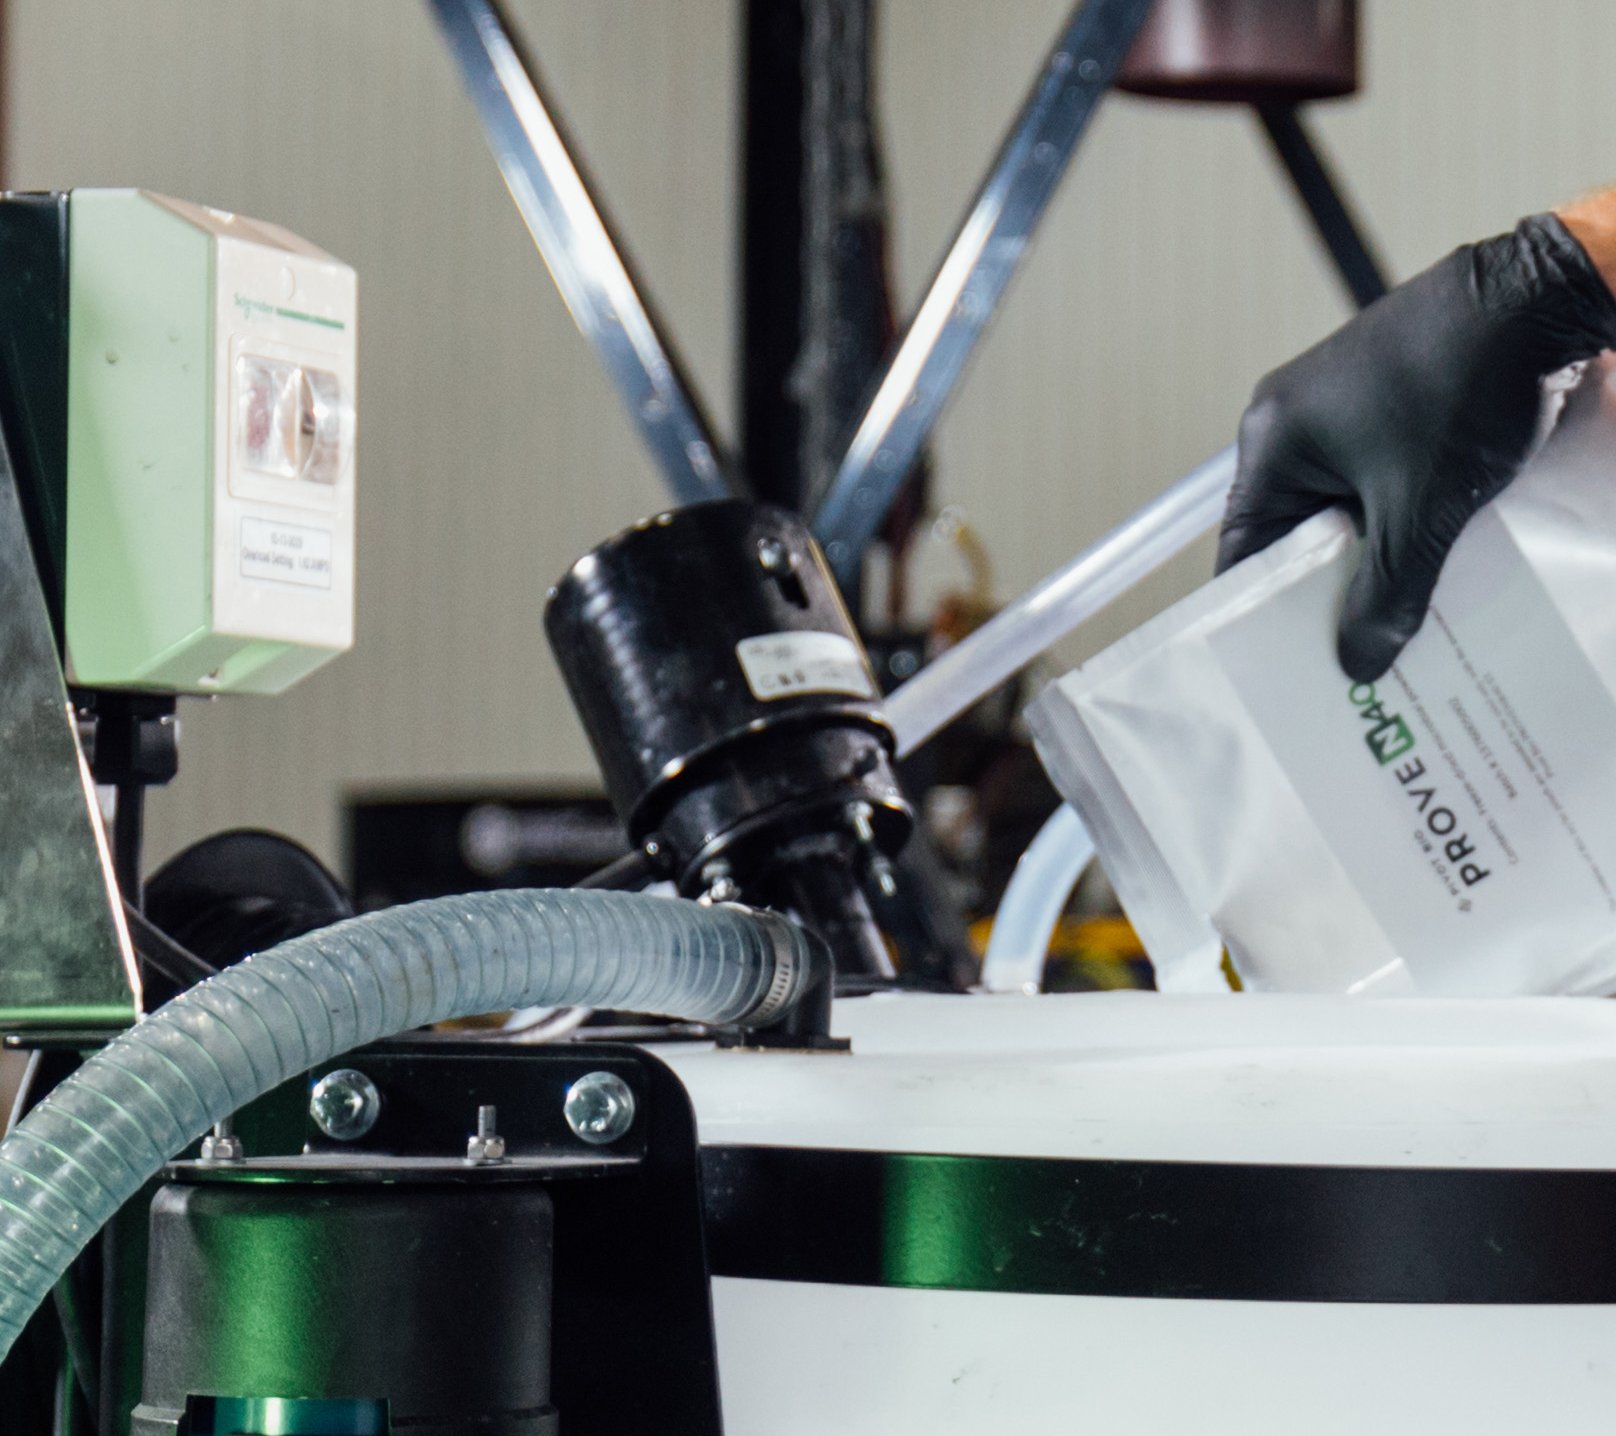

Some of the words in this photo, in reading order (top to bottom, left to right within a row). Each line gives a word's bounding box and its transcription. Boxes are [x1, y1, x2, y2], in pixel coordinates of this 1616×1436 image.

[1411, 702, 1448, 752] microbial
[1495, 769, 1518, 800] Batch
[1393, 755, 1492, 888] PROVE
[1412, 828, 1432, 854] BIO
[1430, 857, 1460, 898] PIVOT
